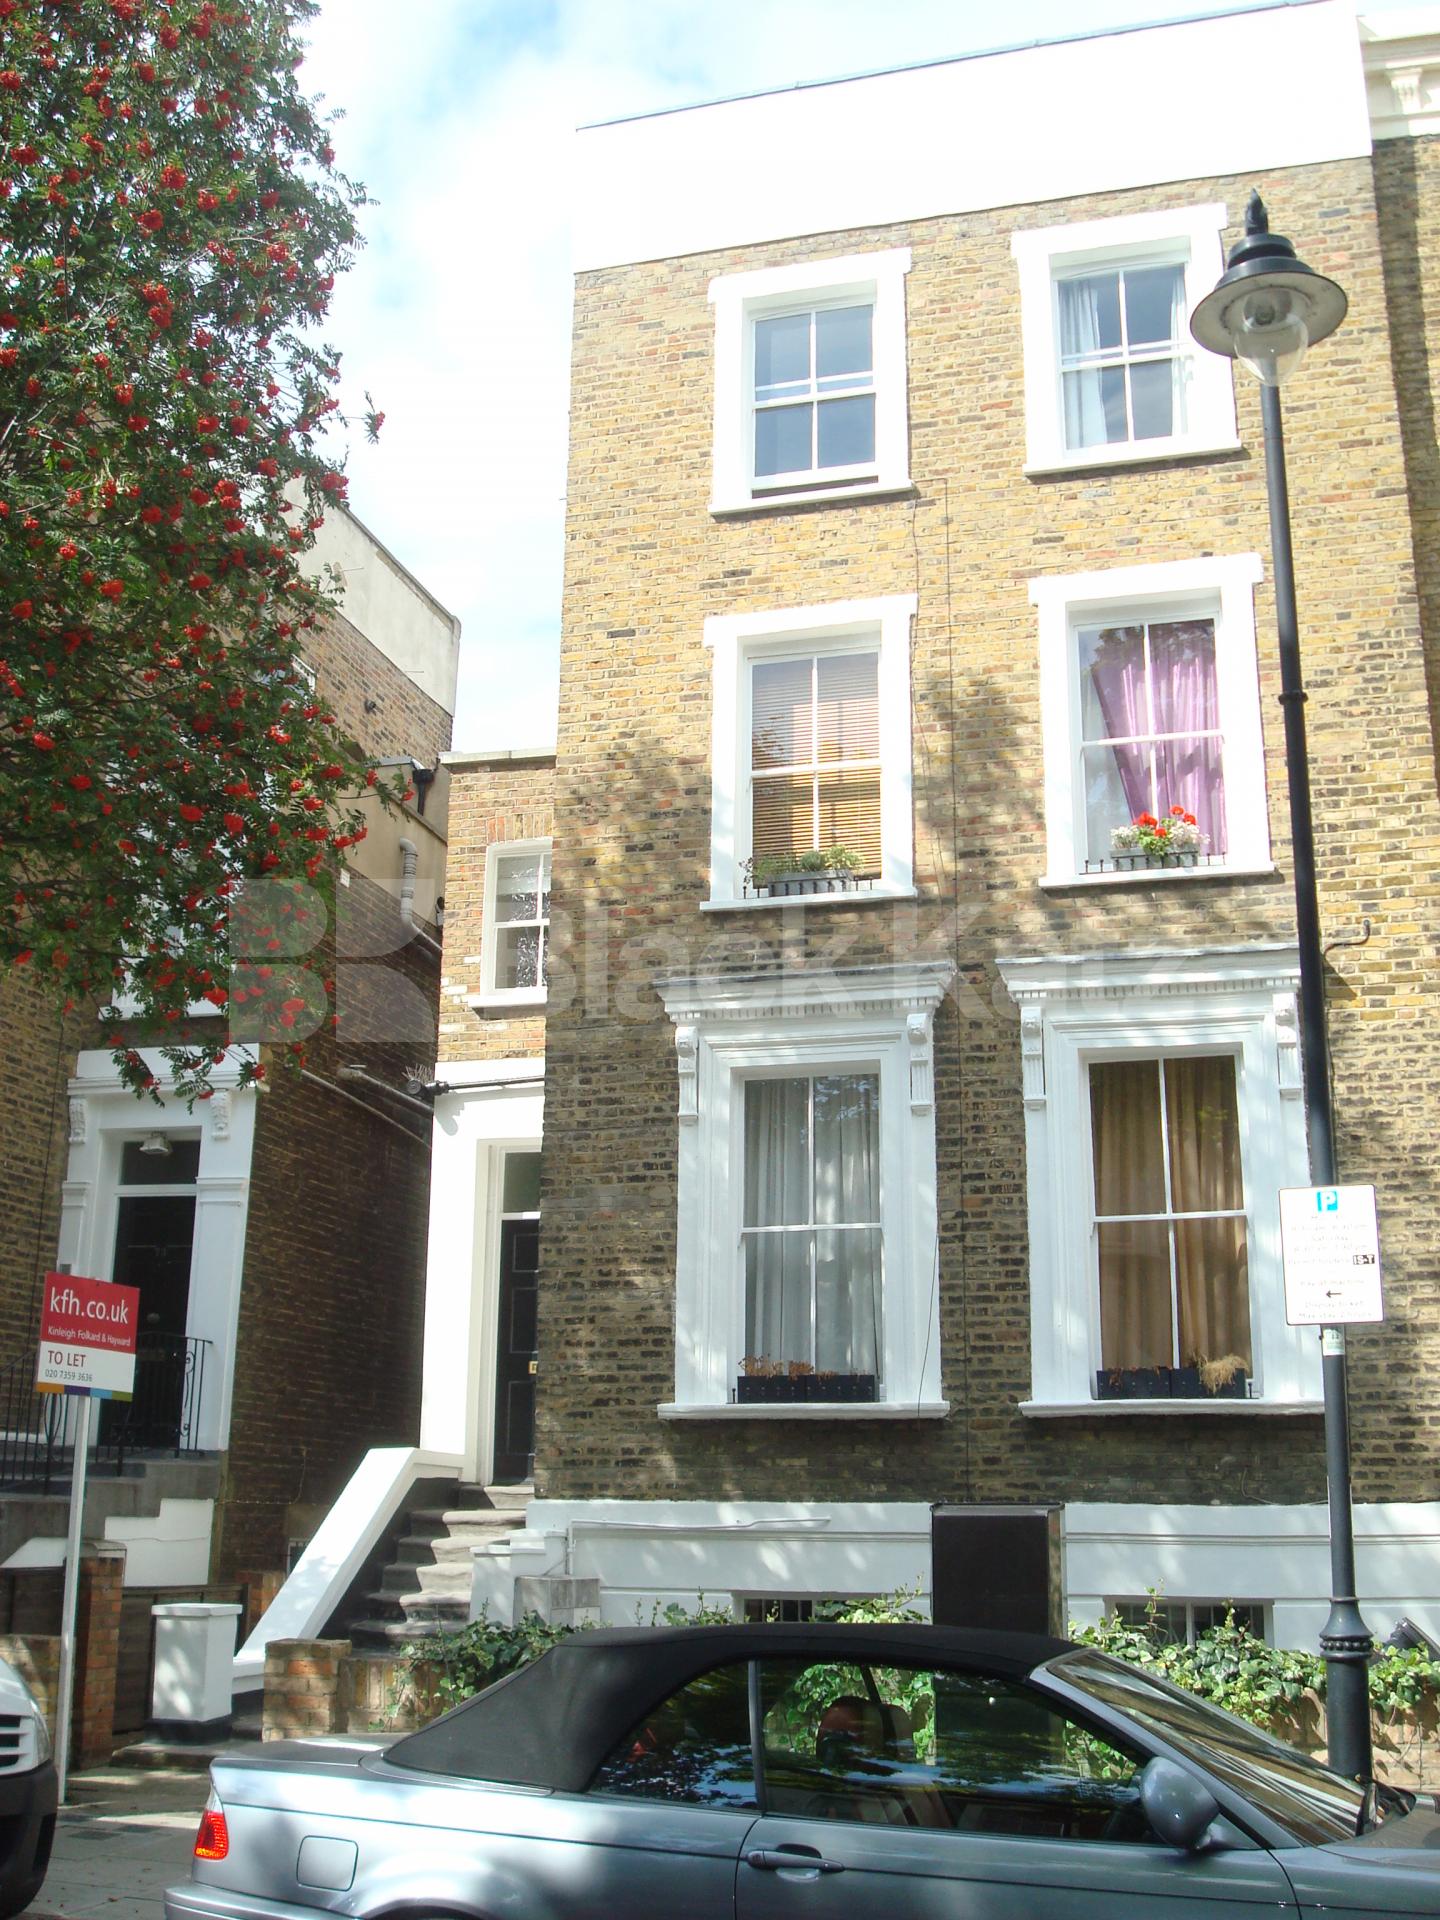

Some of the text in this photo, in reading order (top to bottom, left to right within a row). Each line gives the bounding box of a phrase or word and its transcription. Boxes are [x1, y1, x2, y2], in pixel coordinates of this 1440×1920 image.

[1318, 1191, 1338, 1211] P
[50, 1286, 129, 1324] kfh.co.uk
[48, 1326, 76, 1339] Kinleigh
[48, 1350, 86, 1368] TO LET
[45, 1369, 58, 1378] 020
